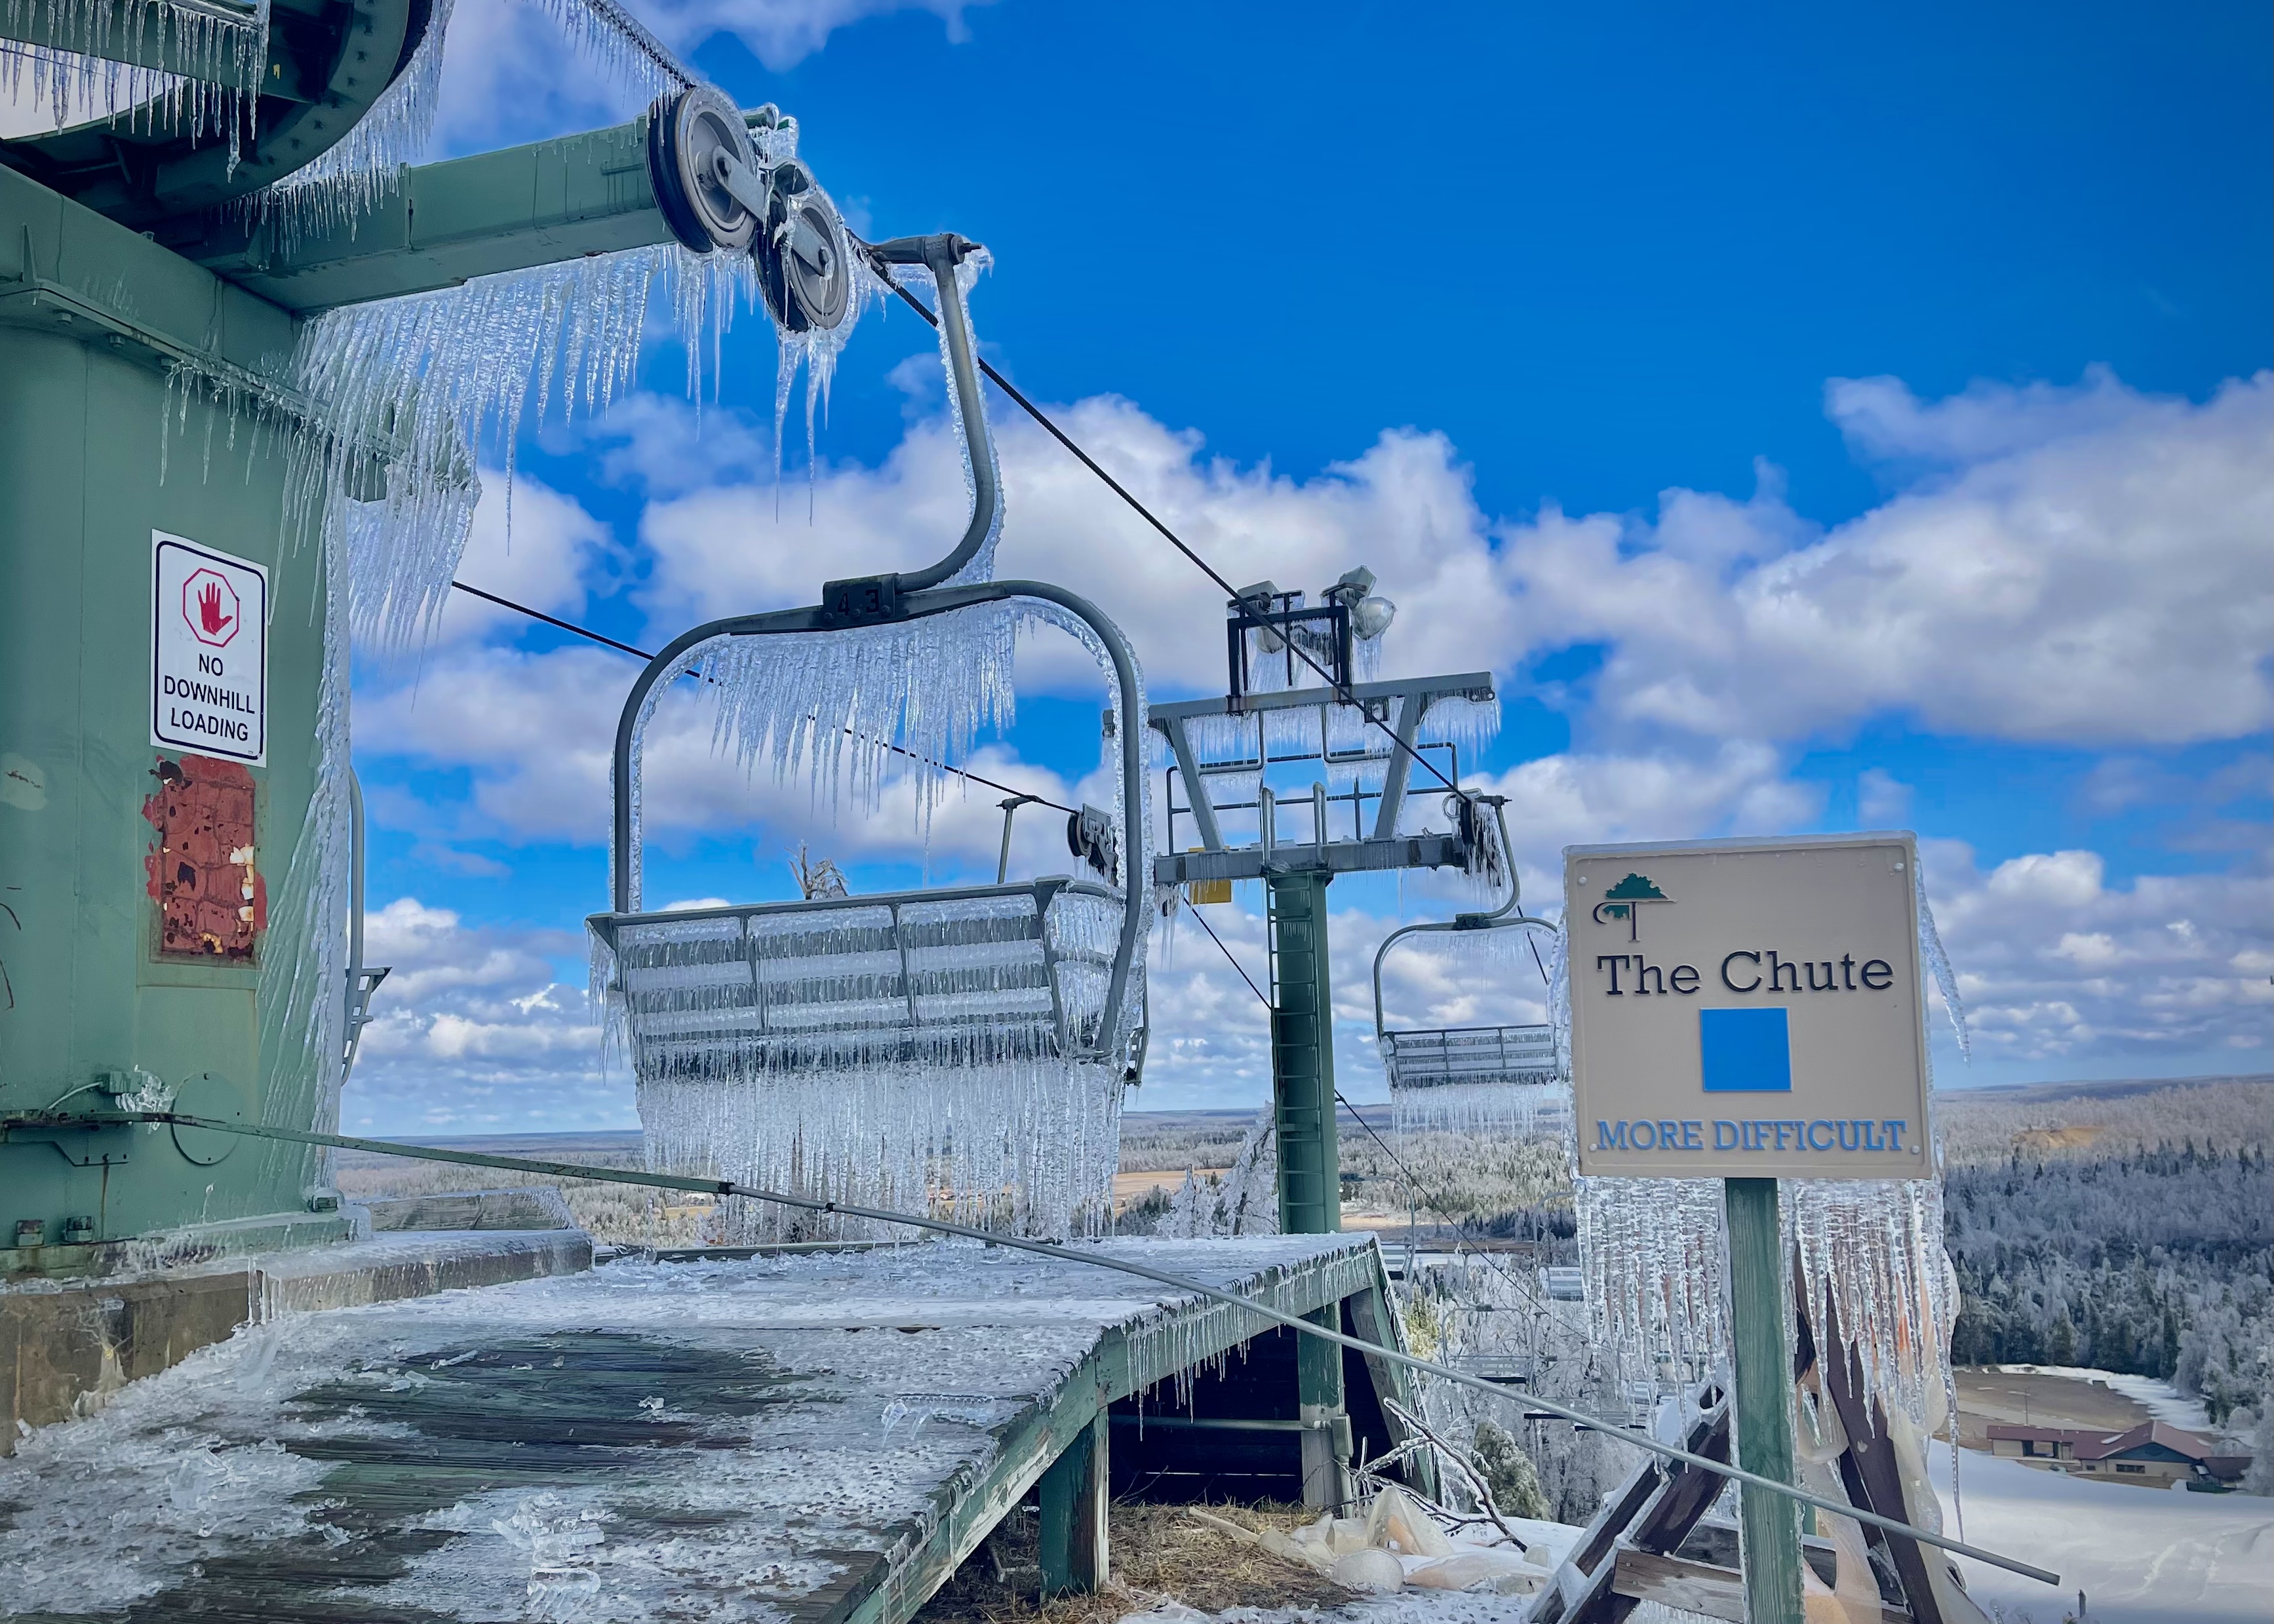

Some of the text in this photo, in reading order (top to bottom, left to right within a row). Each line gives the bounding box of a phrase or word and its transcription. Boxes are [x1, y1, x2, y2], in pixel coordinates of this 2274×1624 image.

[199, 653, 223, 676] NO
[164, 675, 255, 714] DOWNHILL
[170, 707, 248, 741] LOADING
[1597, 950, 1894, 995] The Chute
[1597, 1119, 1907, 1151] MORE DIFFICULT
